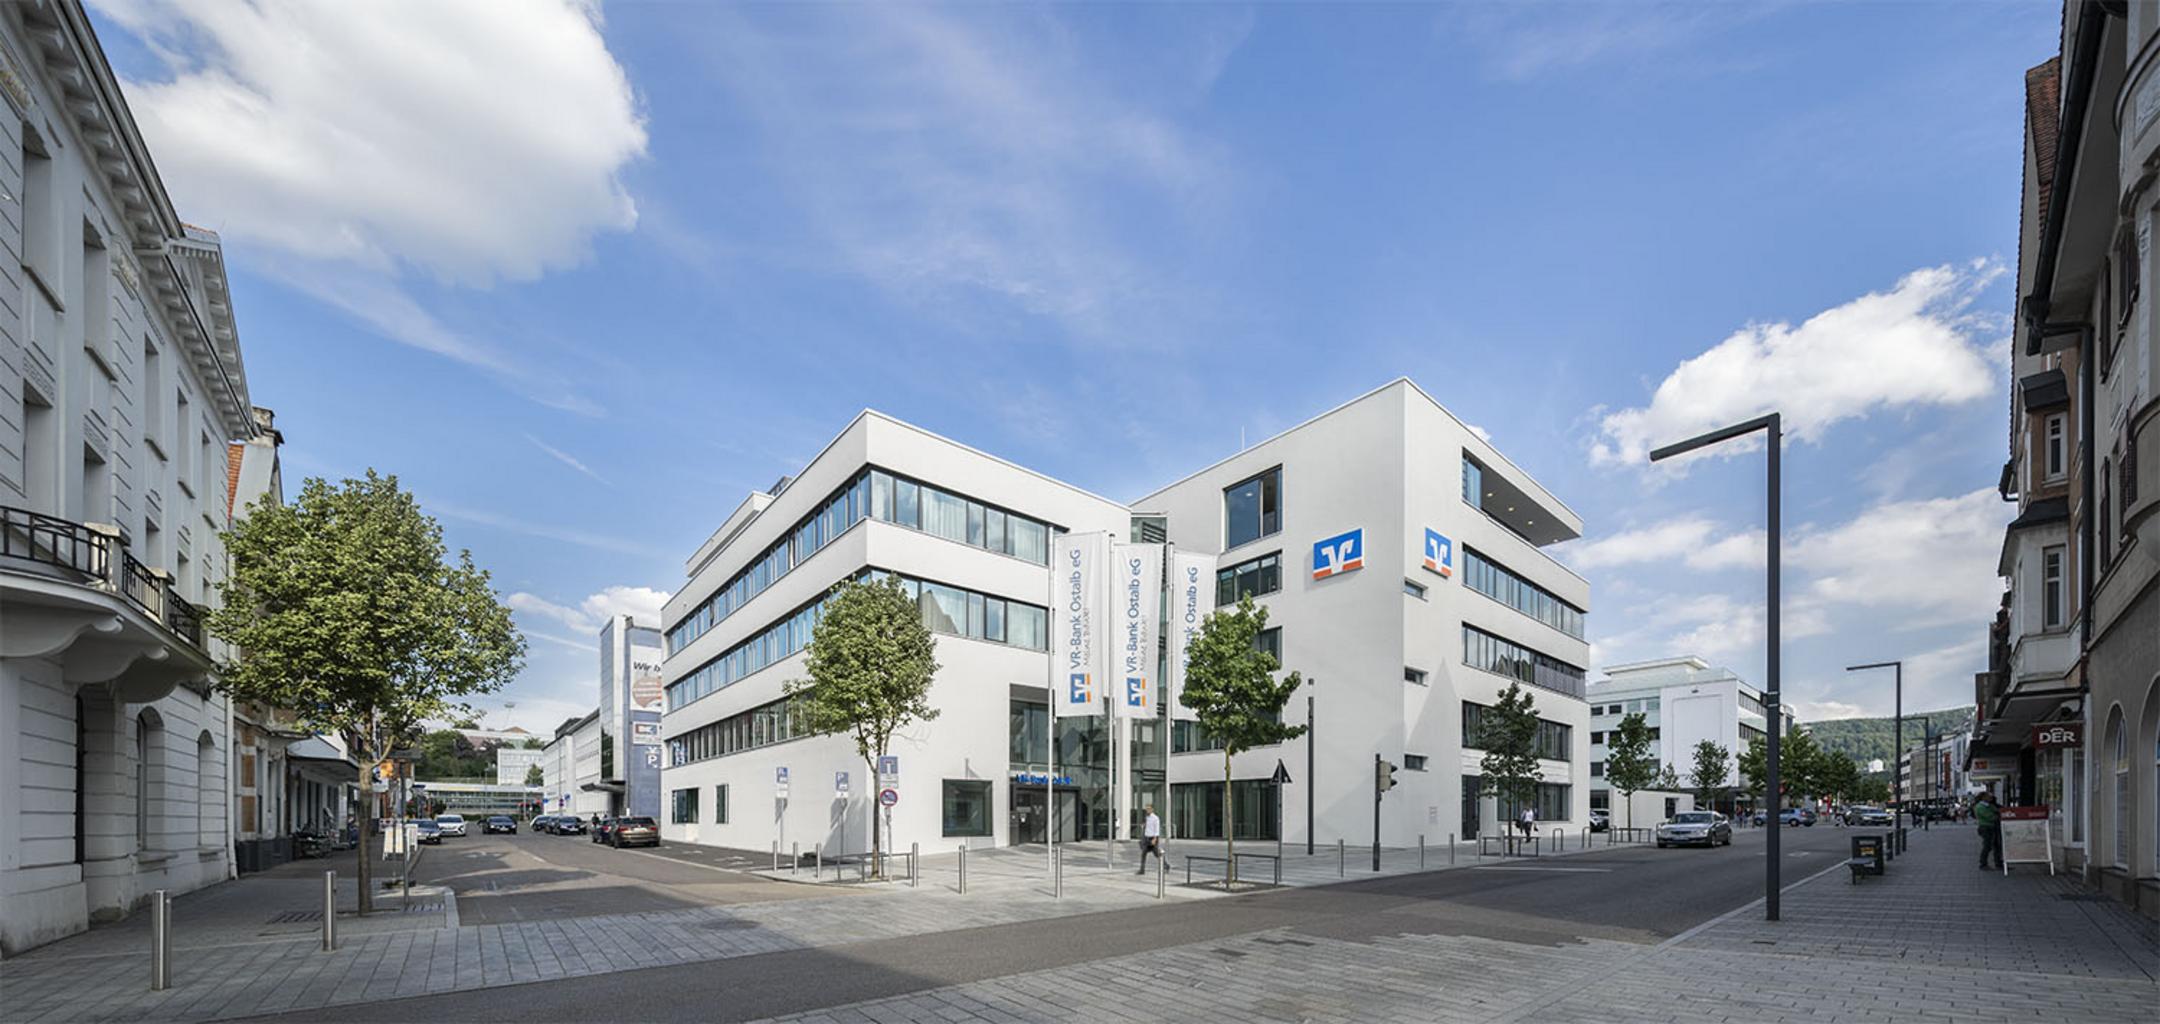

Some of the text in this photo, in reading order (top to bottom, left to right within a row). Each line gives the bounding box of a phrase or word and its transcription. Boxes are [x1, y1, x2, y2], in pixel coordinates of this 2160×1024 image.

[1187, 566, 1198, 583] eG
[1070, 549, 1081, 670] VR-Bank Ostalb eG
[1126, 558, 1141, 673] VR-Bank Ostalb eG
[1185, 586, 1197, 623] Ostalb
[633, 662, 651, 672] Wir
[2039, 730, 2076, 743] DER
